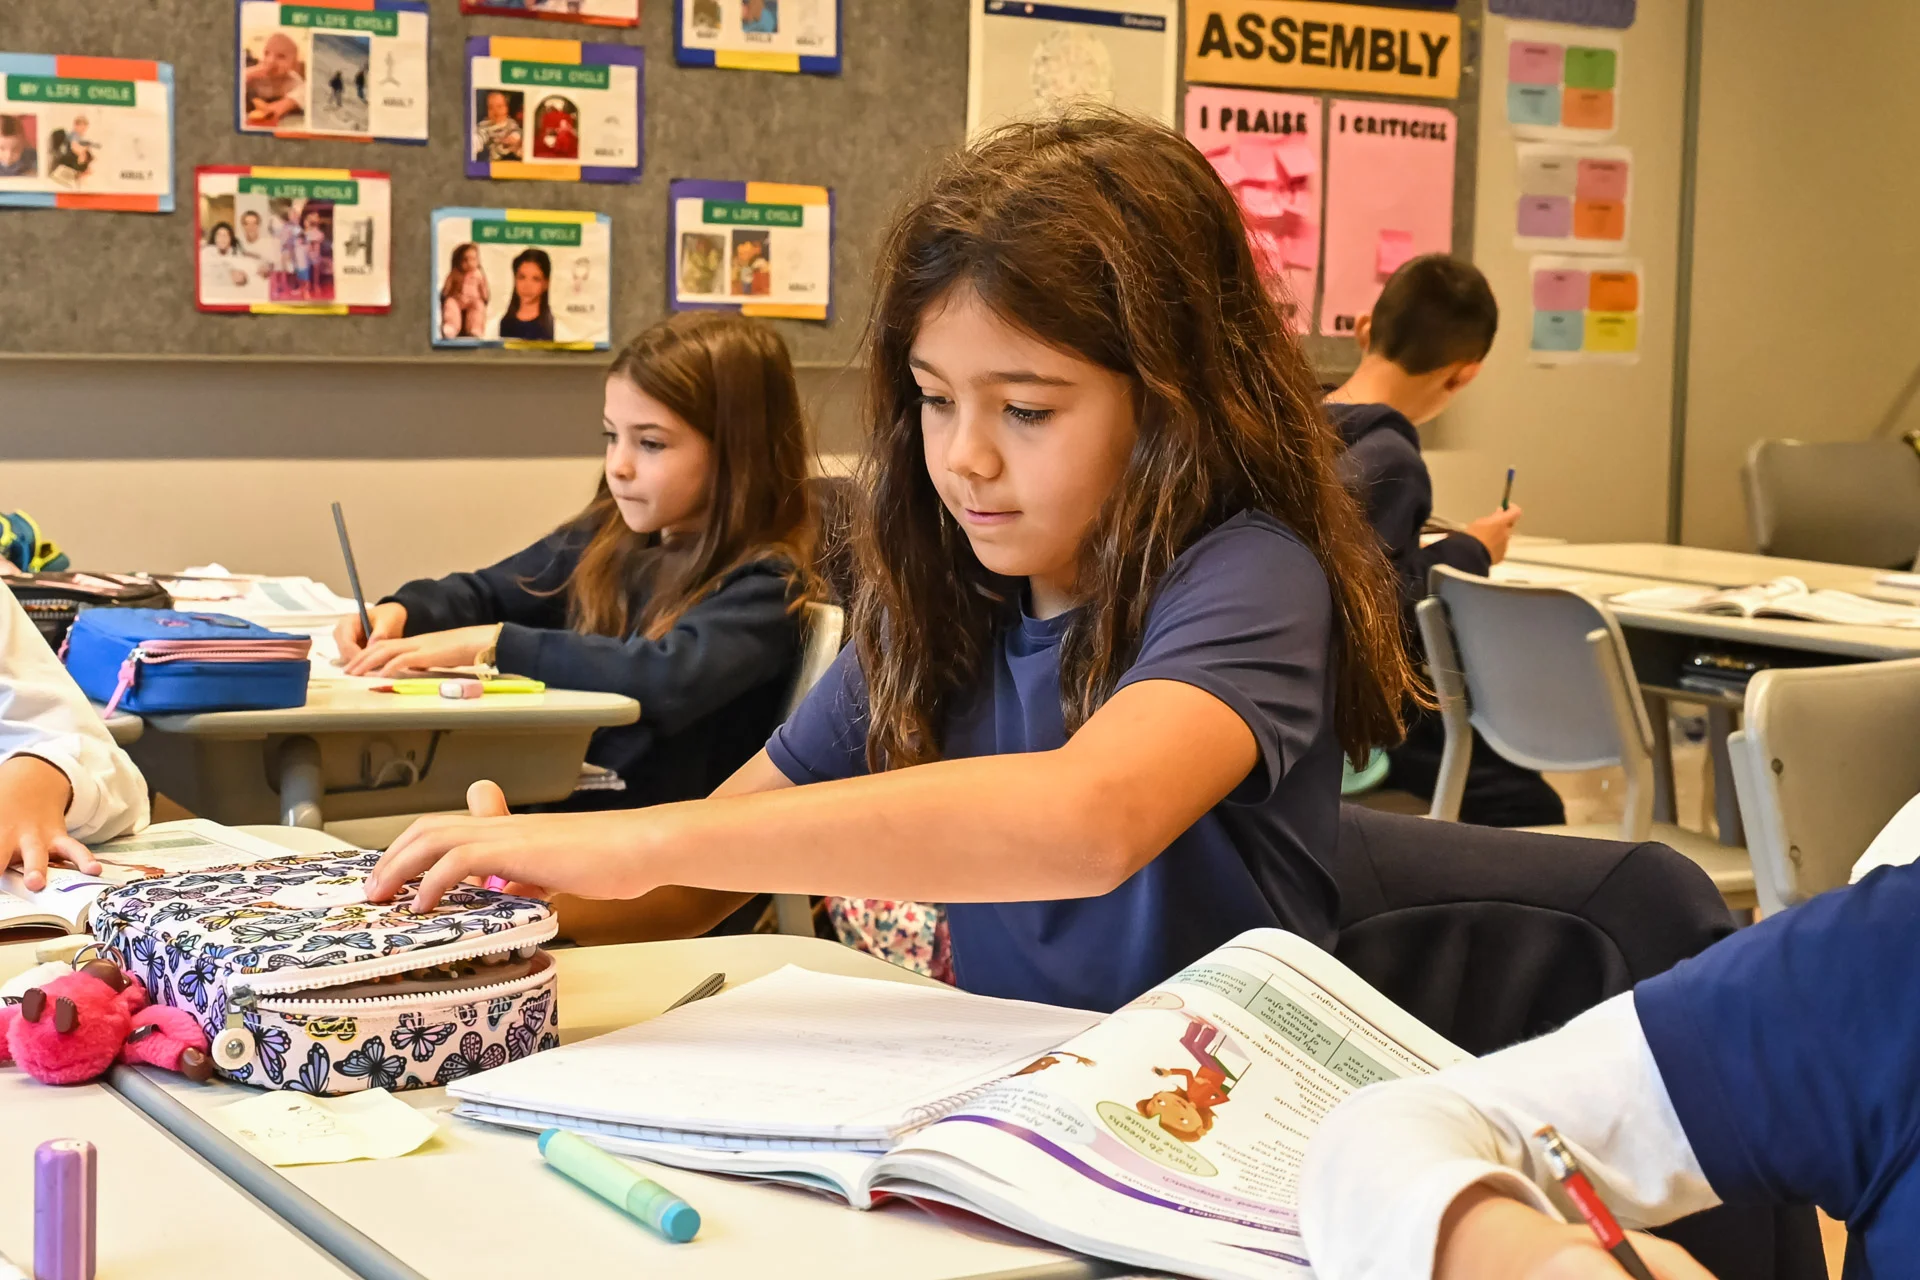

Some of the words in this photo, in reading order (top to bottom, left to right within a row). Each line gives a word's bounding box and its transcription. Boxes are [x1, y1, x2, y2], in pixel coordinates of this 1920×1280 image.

[290, 11, 310, 25] MY
[315, 13, 348, 28] LIFE
[353, 15, 393, 31] CYCLE
[1197, 12, 1451, 78] ASSEMBLY
[510, 67, 528, 79] MY
[533, 68, 562, 82] LIFE
[568, 70, 605, 85] CYCLE
[19, 82, 39, 96] MY
[46, 83, 81, 99] LIFE
[88, 85, 130, 101] CYCLE
[1201, 106, 1208, 130] I
[1220, 107, 1308, 135] PRAISE
[1339, 113, 1347, 133] I
[1354, 116, 1448, 141] CRITICISE
[250, 185, 268, 195] MY
[274, 184, 307, 198] LIFE
[313, 185, 353, 200] CYCLE
[712, 206, 728, 219] MY
[732, 207, 760, 221] LIFE
[765, 208, 798, 223] CYCLE
[482, 226, 499, 239] MY
[505, 226, 534, 240] LIFE
[540, 228, 577, 241] CYCLE
[1195, 978, 1231, 995] Number
[1210, 976, 1243, 994] breaths
[1215, 971, 1247, 987] minute
[1263, 996, 1284, 1011] after
[1311, 992, 1338, 1011] right?
[1267, 1006, 1276, 1015] in
[1286, 1002, 1318, 1027] exercise
[1260, 1010, 1302, 1042] prediction
[1277, 1014, 1308, 1039] breaths
[1286, 1011, 1314, 1033] minute
[1339, 1010, 1388, 1048] predictions
[1251, 1039, 1273, 1057] after
[1303, 1041, 1317, 1055] My
[1309, 1037, 1319, 1046] of
[1316, 1033, 1331, 1046] one
[1348, 1056, 1364, 1069] rest
[1389, 1047, 1409, 1063] your
[1274, 1057, 1294, 1073] rate
[1296, 1058, 1316, 1074] your
[1333, 1063, 1343, 1073] of
[1343, 1061, 1360, 1074] one
[1366, 1068, 1376, 1077] at
[1318, 1073, 1340, 1090] from
[1027, 1089, 1049, 1099] one
[1021, 1096, 1051, 1110] times
[1274, 1096, 1308, 1119] minute
[1015, 1112, 1045, 1127] After
[1020, 1104, 1063, 1127] exercise
[1054, 1106, 1085, 1128] many
[1065, 1123, 1079, 1136] of
[1108, 1113, 1146, 1144] breaths
[1124, 1114, 1161, 1142] minute
[1149, 1142, 1165, 1155] 26
[1163, 1140, 1183, 1155] one
[1168, 1152, 1199, 1173] That's
[1186, 1154, 1197, 1162] in
[1222, 1152, 1259, 1170] predict
[1161, 1174, 1221, 1199] stopwatch
